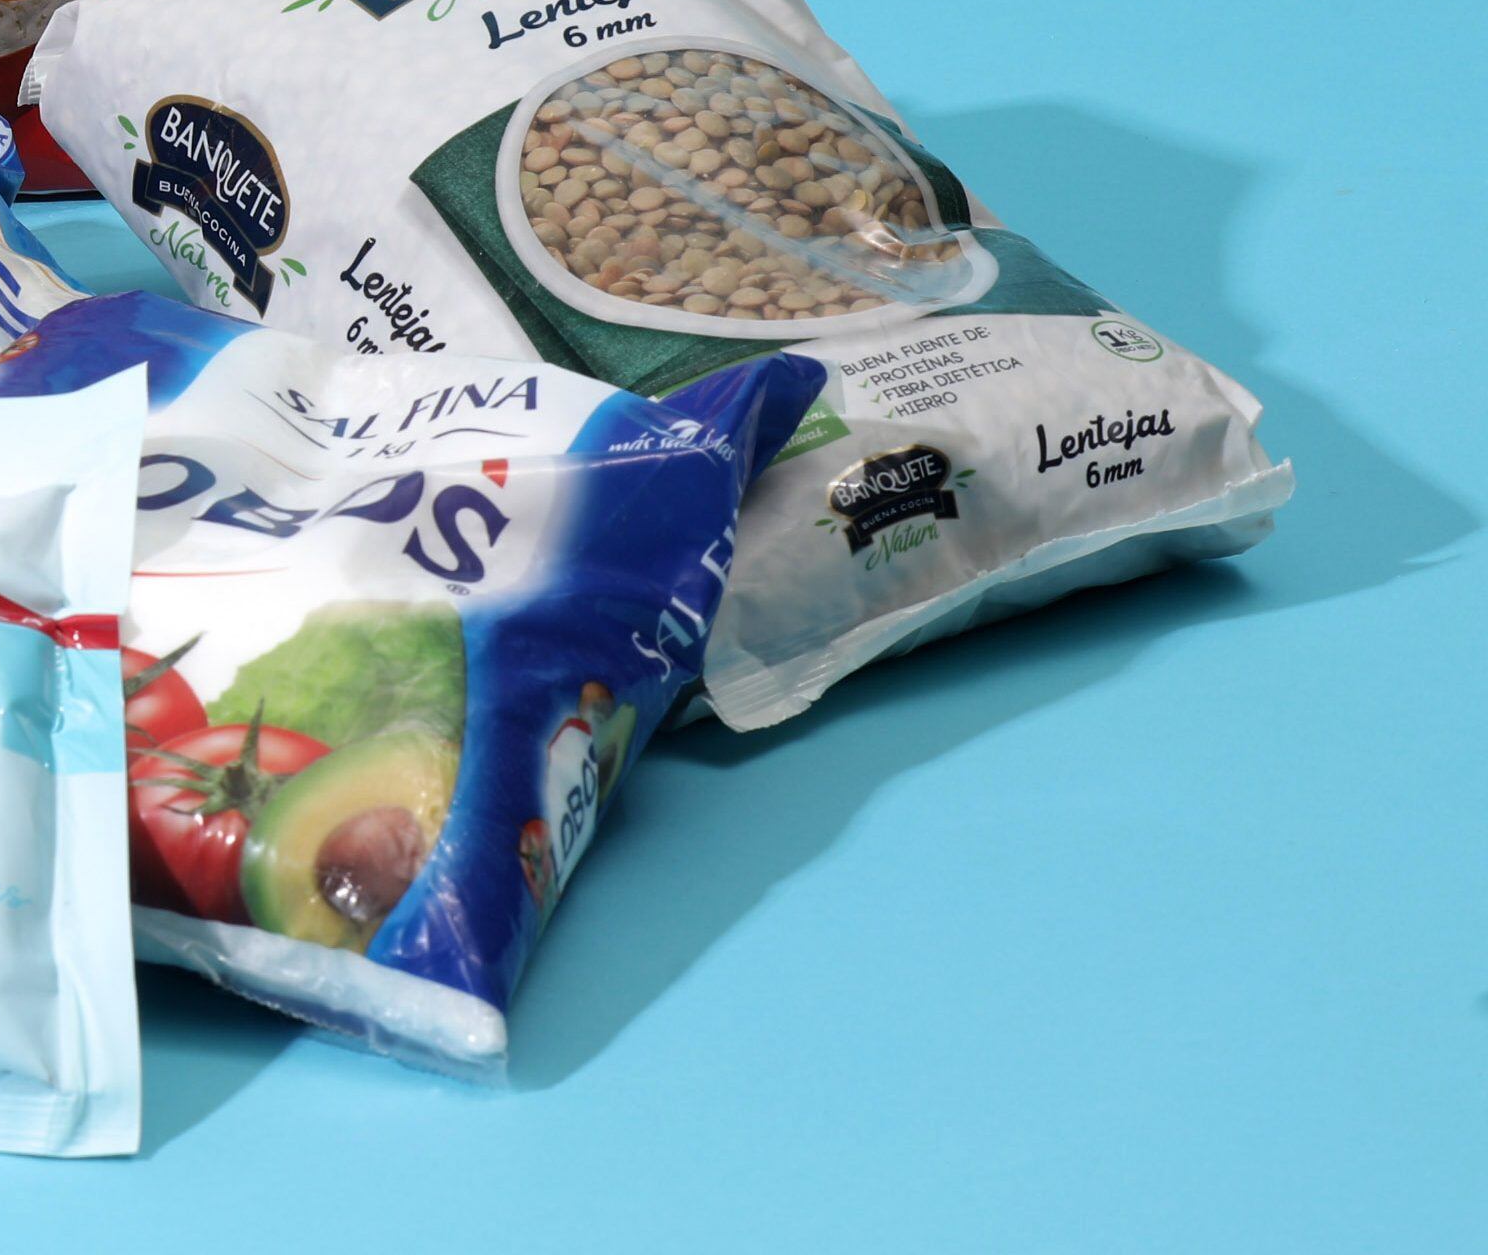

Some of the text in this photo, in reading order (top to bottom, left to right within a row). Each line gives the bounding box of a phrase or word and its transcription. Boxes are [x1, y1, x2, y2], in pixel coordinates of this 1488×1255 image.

[563, 12, 657, 48] 6 mm
[160, 107, 282, 235] BANQUETE
[159, 181, 246, 267] BUENA COCINA
[347, 316, 368, 343] 6
[1097, 330, 1128, 347] 1
[841, 325, 991, 377] BUENA FUENTE DE:
[870, 351, 964, 386] PROTEÍNAS
[883, 356, 1023, 401] FIBRA DIETÉTICA
[274, 376, 538, 438] SAL FINA
[894, 391, 958, 418] HIERRO
[374, 441, 416, 459] kg
[1036, 409, 1176, 473] Lentejas
[835, 454, 936, 507] BANQUETE
[1104, 456, 1144, 485] mm
[862, 496, 935, 531] BUENA COCINA
[866, 522, 939, 571] Natura
